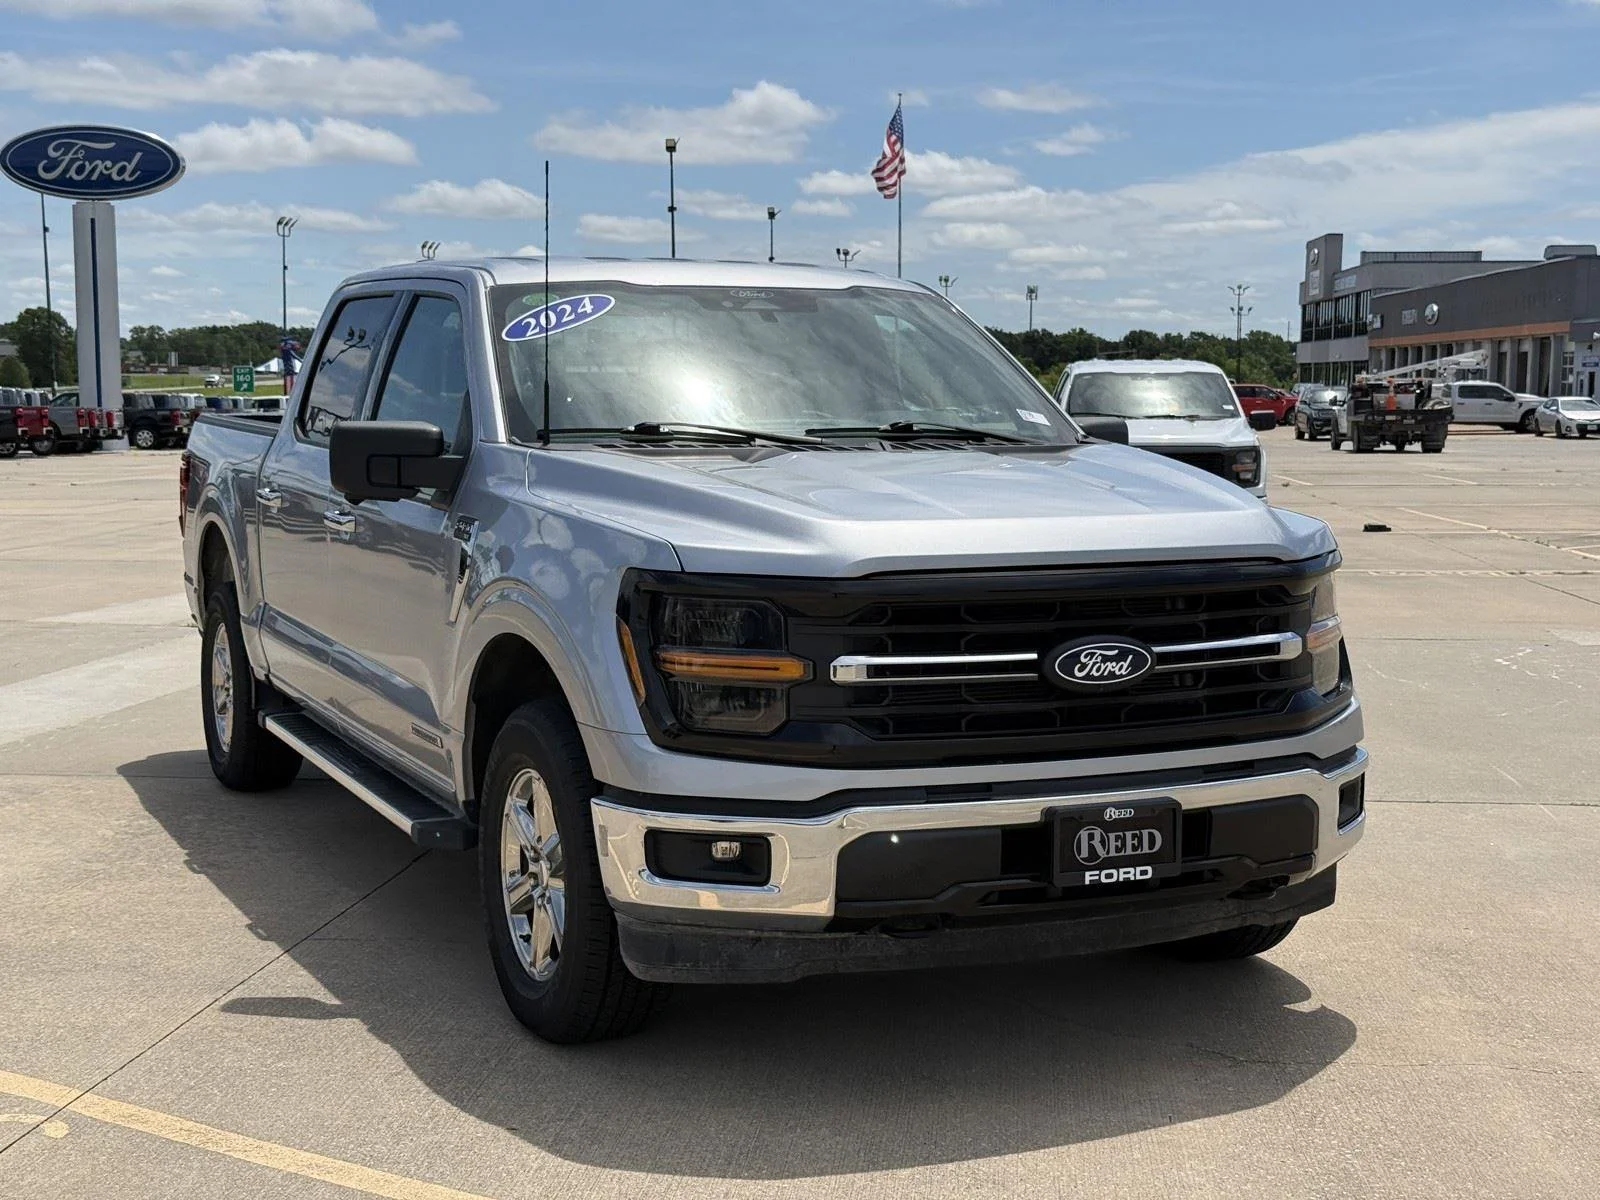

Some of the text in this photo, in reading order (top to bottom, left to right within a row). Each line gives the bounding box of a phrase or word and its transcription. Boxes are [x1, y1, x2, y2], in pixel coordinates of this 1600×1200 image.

[38, 139, 143, 182] Ford
[521, 296, 594, 337] 2024
[236, 374, 251, 382] 160
[1074, 649, 1133, 678] Ford
[1104, 807, 1134, 820] REED
[1076, 827, 1162, 863] REED
[1084, 865, 1153, 885] FORD
